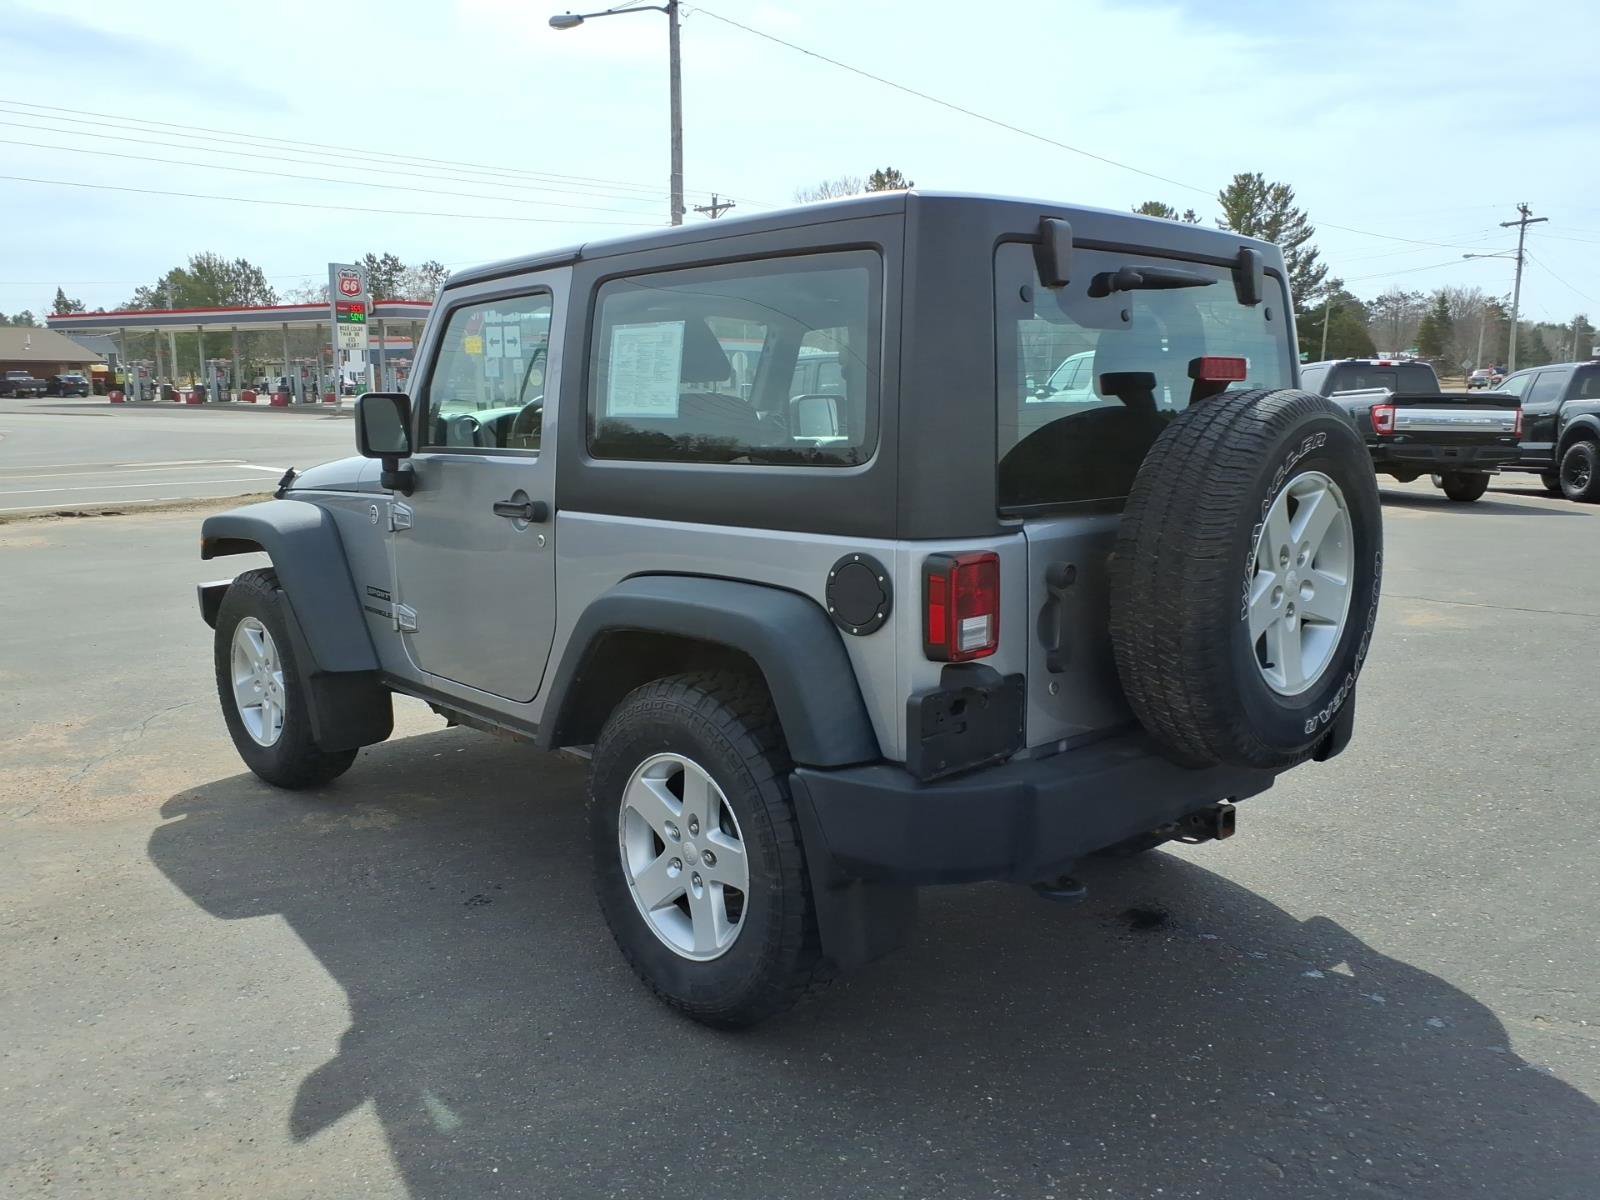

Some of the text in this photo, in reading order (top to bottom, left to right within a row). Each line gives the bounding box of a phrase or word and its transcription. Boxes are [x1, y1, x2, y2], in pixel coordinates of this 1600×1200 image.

[342, 280, 358, 291] 66
[1241, 432, 1327, 621] WRANGLER
[367, 585, 391, 601] SPORT
[364, 605, 392, 619] WRANGLE
[1304, 551, 1382, 734] GOODYEAR
